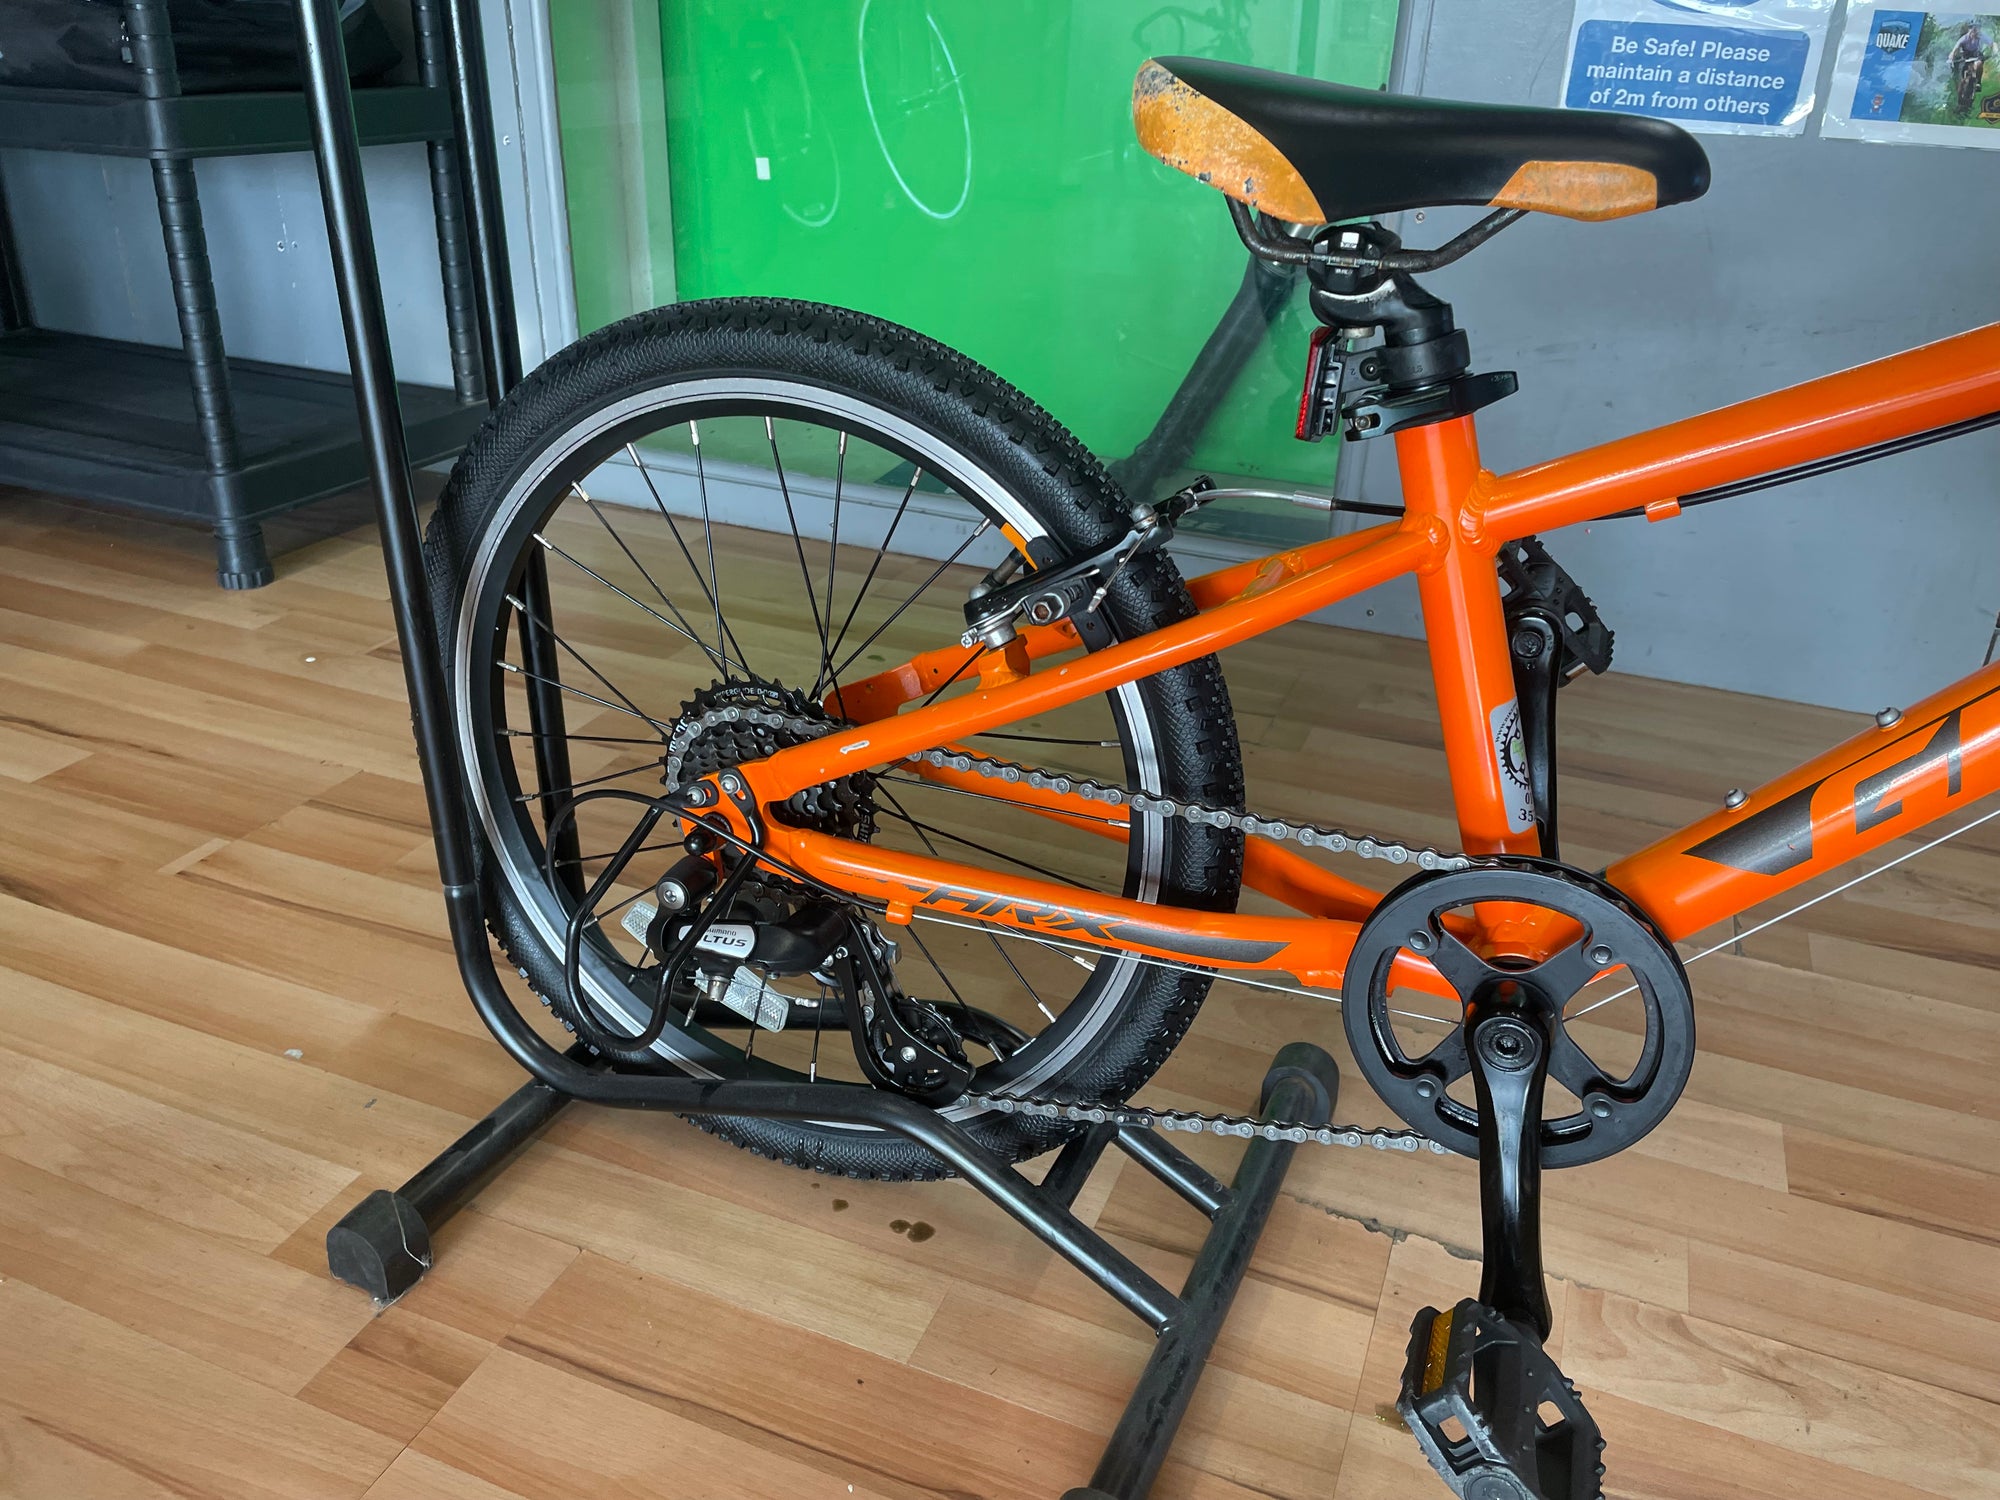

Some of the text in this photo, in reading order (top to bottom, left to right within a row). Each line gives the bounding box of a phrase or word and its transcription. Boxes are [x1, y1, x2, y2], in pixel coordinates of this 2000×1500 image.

[1611, 35, 1771, 62] Be Safe! Please
[1875, 33, 1911, 49] QUAKE
[1586, 62, 1785, 90] maintain a distance
[1589, 87, 1770, 116] of 2m from others
[703, 935, 747, 947] LTUS
